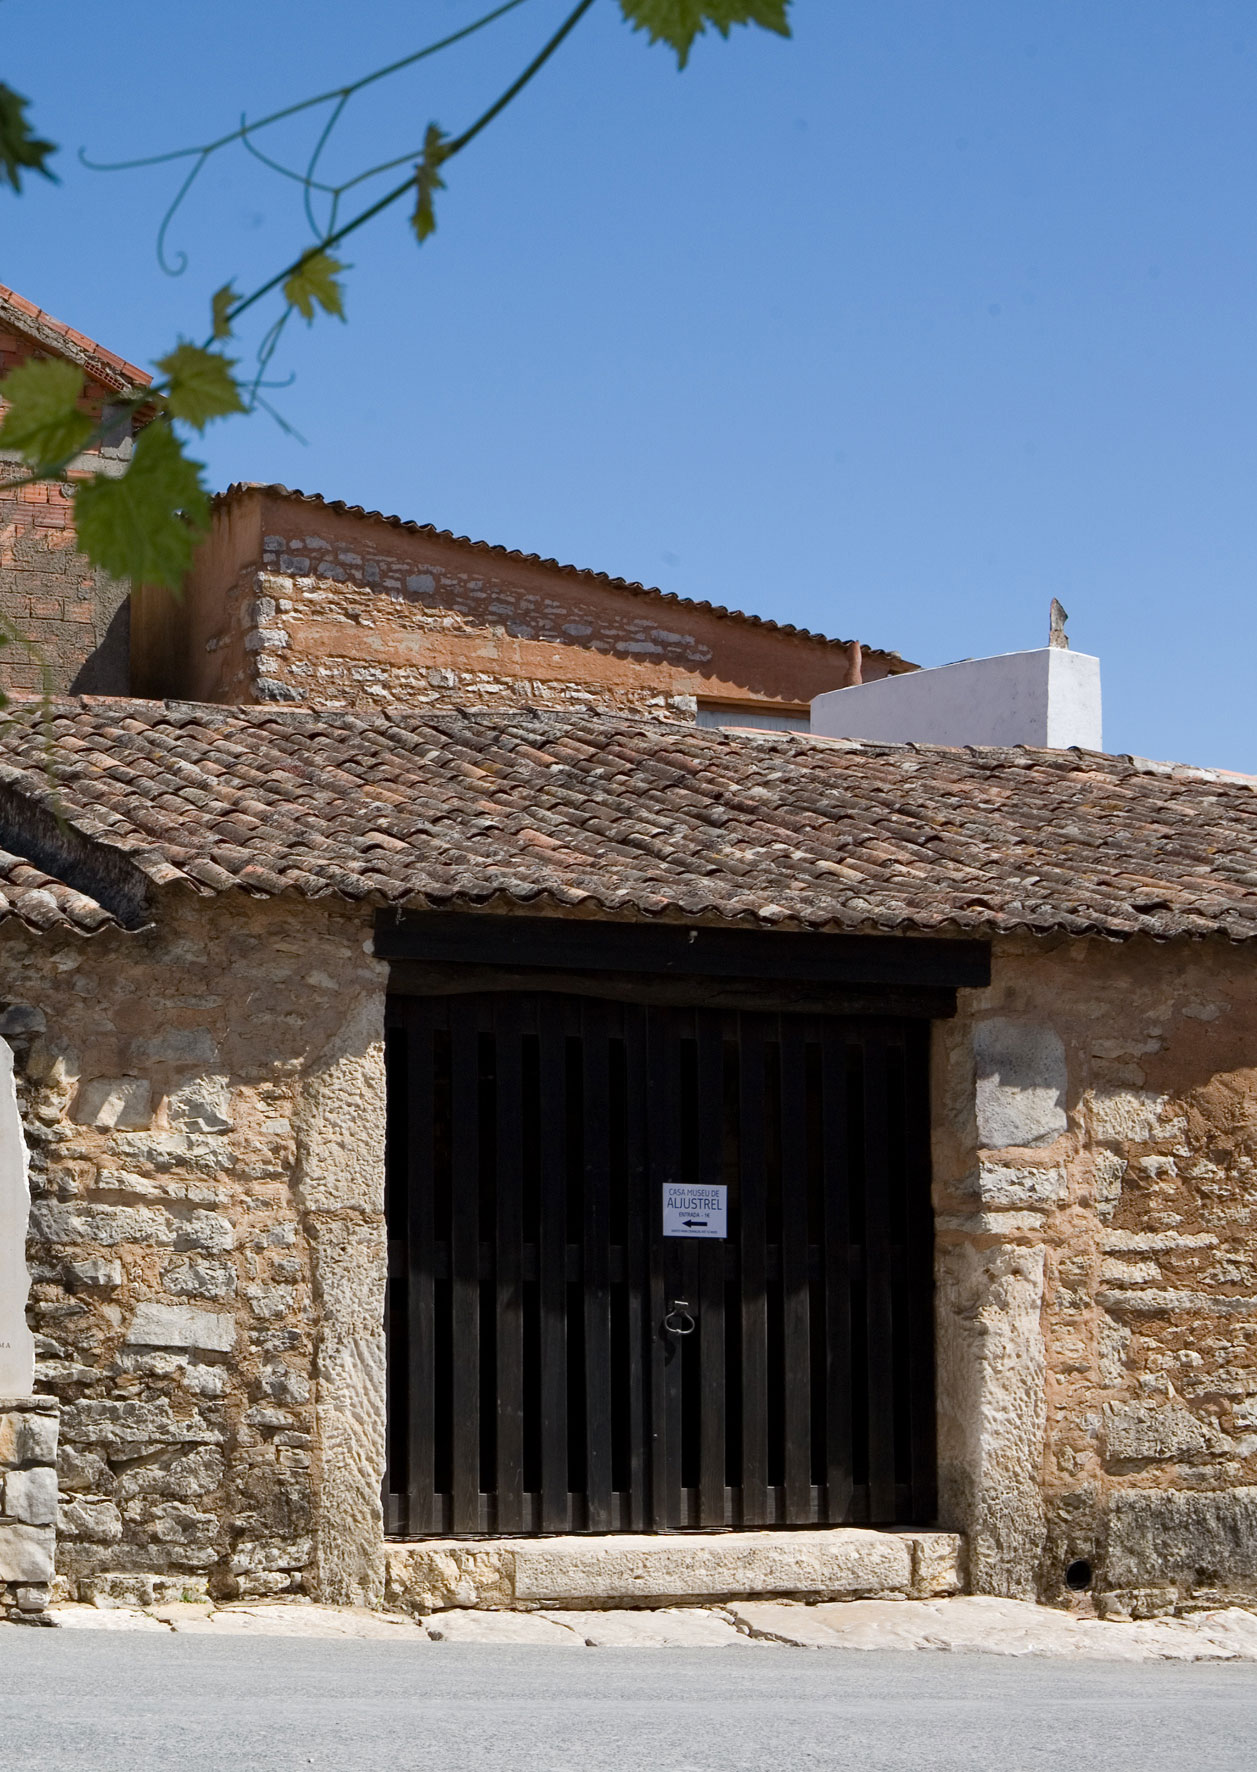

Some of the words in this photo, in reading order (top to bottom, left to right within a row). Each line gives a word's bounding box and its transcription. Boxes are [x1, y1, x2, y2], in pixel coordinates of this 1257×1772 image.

[669, 1188, 685, 1196] CASA
[687, 1189, 710, 1197] MUSEU
[667, 1197, 722, 1210] ALJUSTREL
